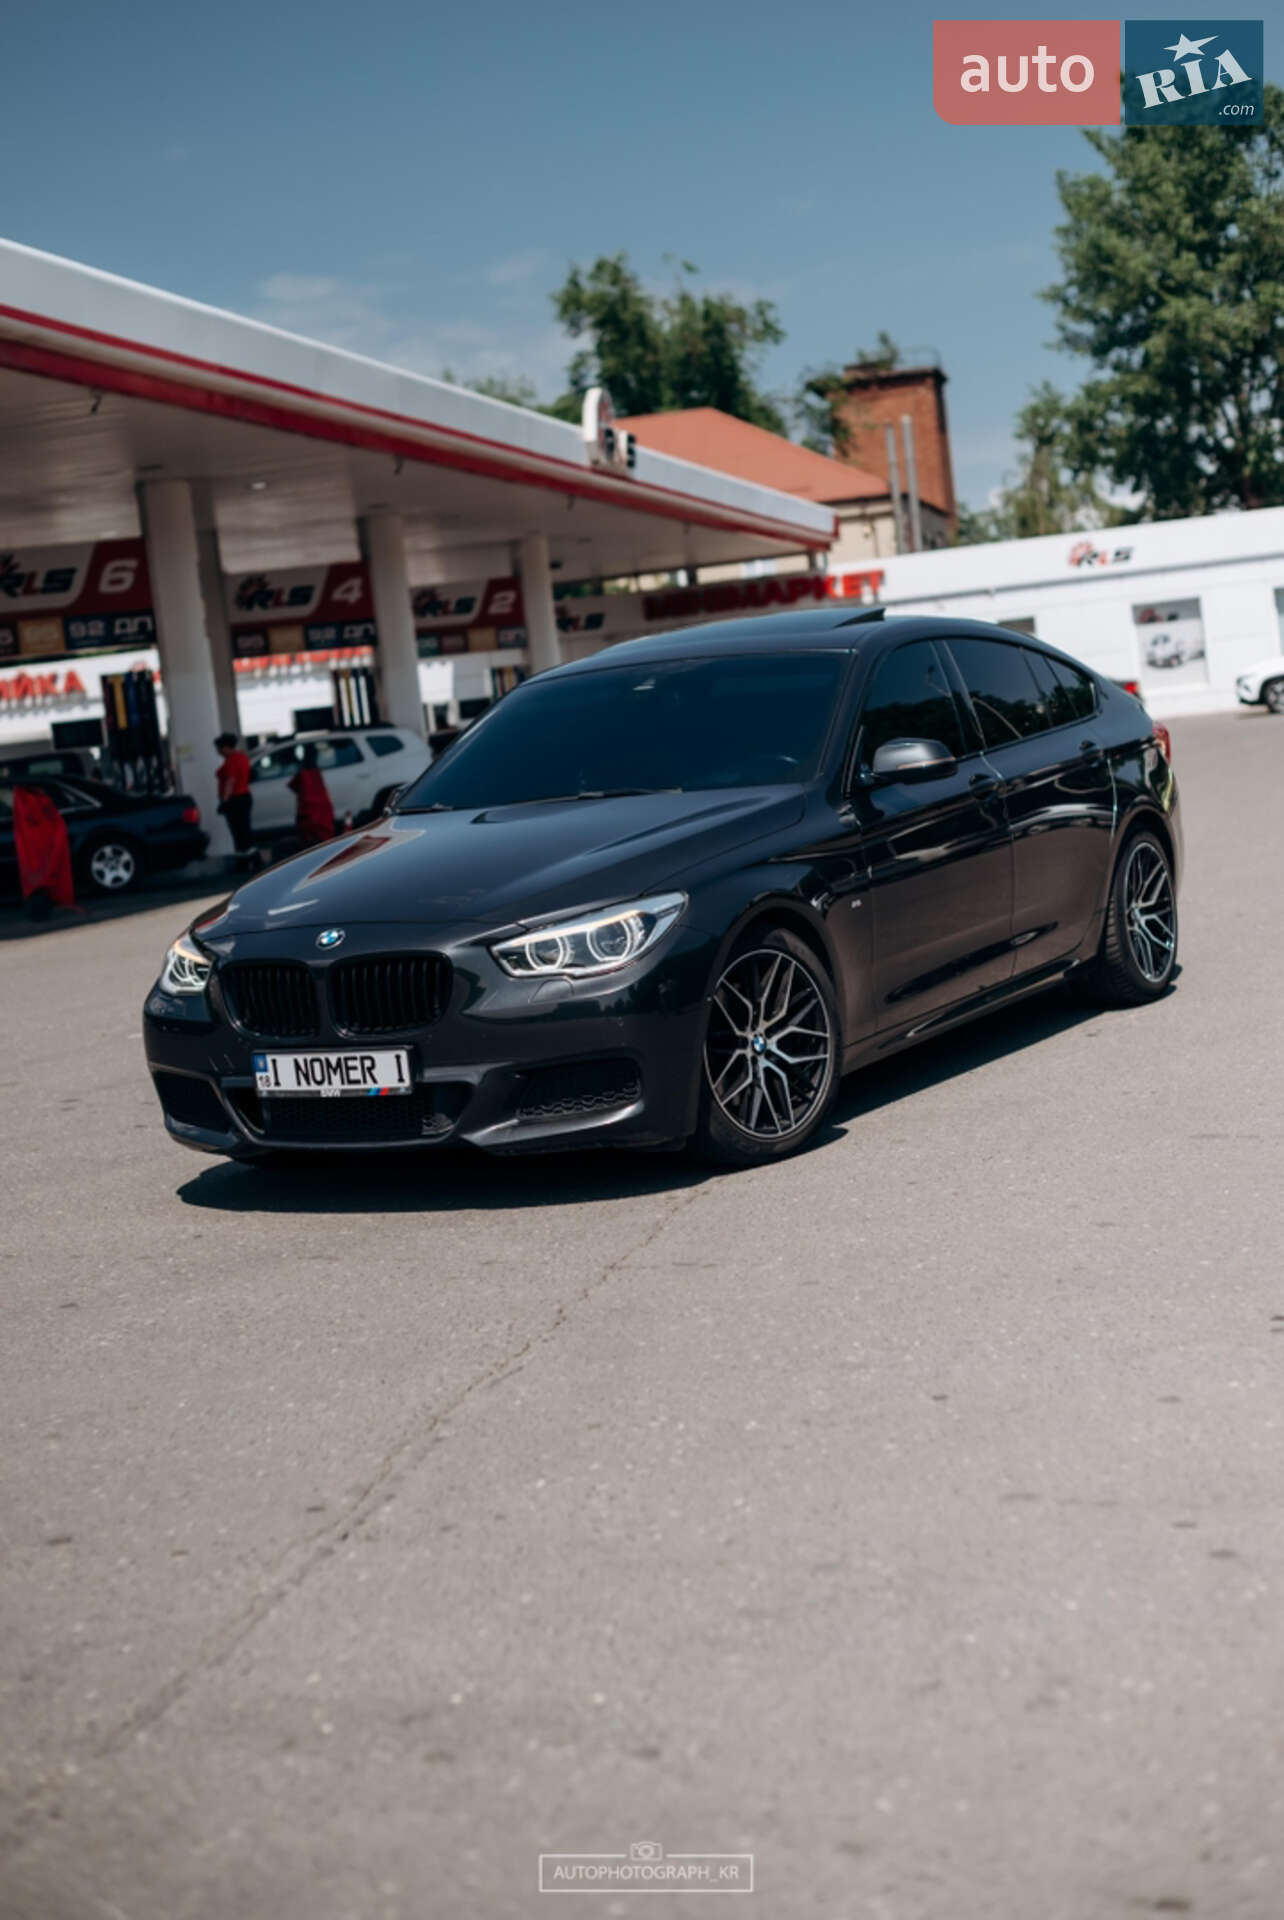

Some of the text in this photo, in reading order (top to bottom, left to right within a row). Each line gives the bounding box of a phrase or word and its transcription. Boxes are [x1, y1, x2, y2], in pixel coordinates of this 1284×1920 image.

[97, 558, 140, 595] 6
[331, 578, 362, 604] 4
[487, 589, 516, 615] 2
[293, 1055, 378, 1087] NOMER
